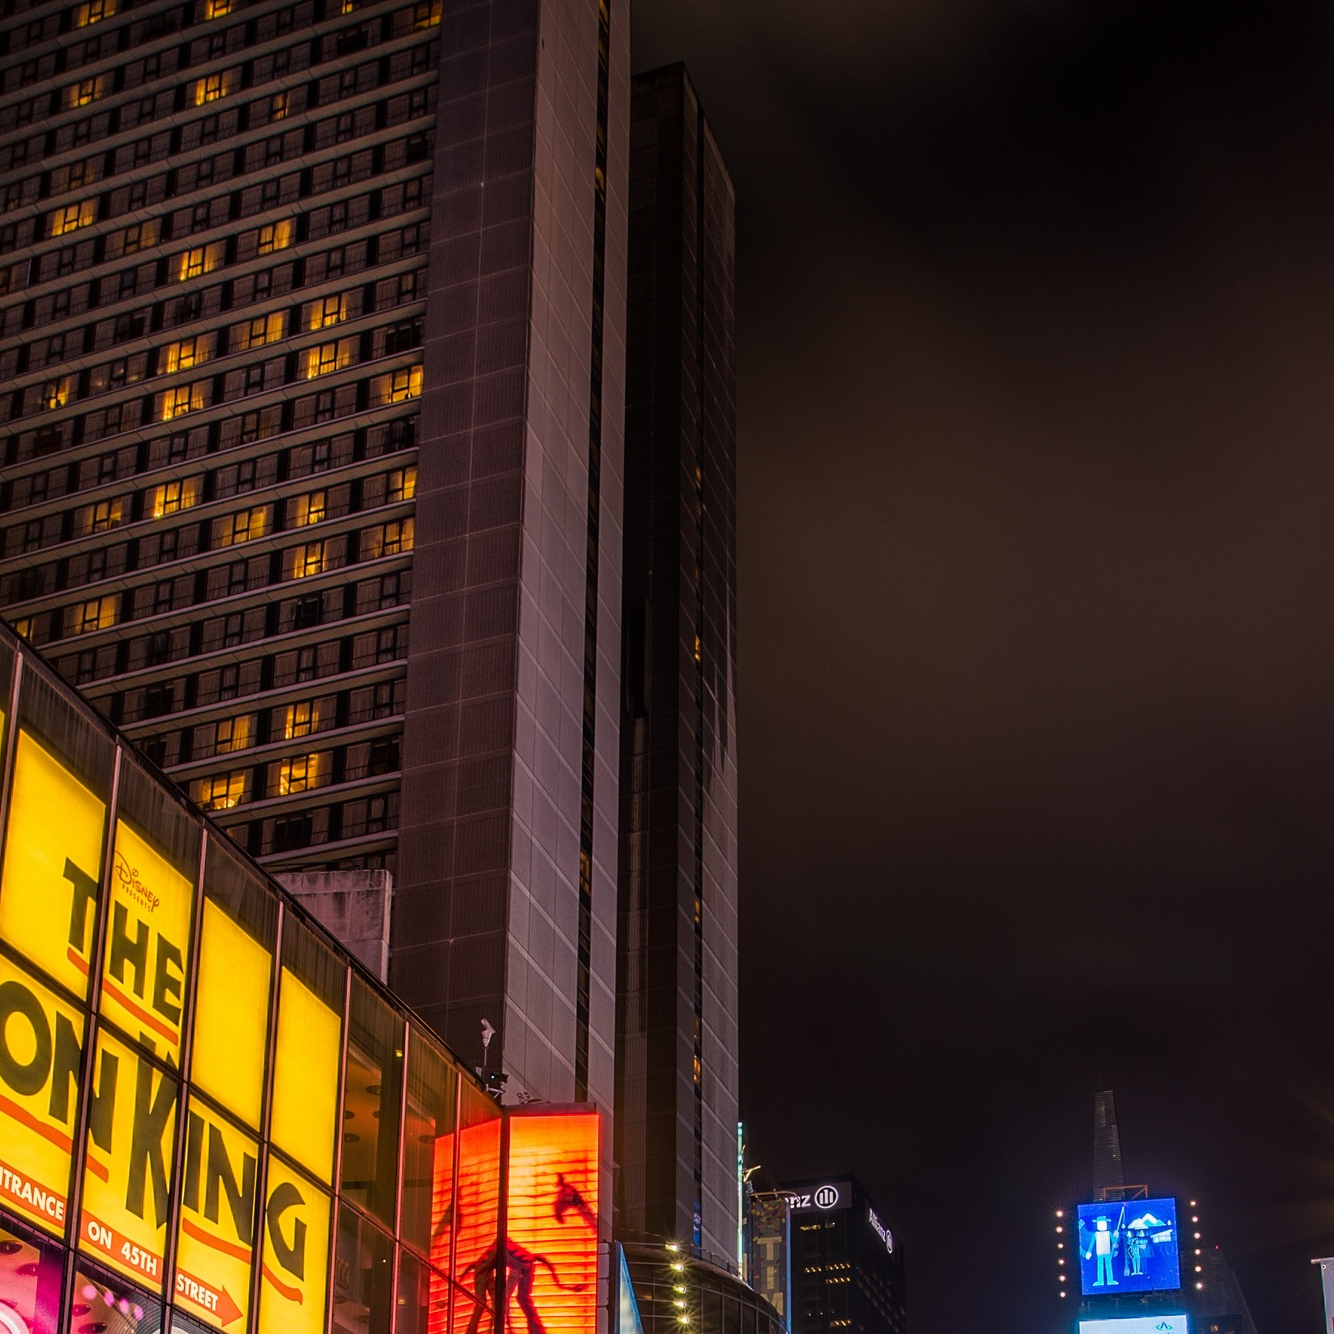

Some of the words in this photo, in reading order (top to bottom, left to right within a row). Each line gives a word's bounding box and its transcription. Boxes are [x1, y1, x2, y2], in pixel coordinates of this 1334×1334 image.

[62, 857, 184, 1019] THE
[126, 1031, 307, 1283] KING
[87, 1220, 113, 1251] ON
[120, 1240, 158, 1279] 45TH
[176, 1273, 220, 1312] STREET
